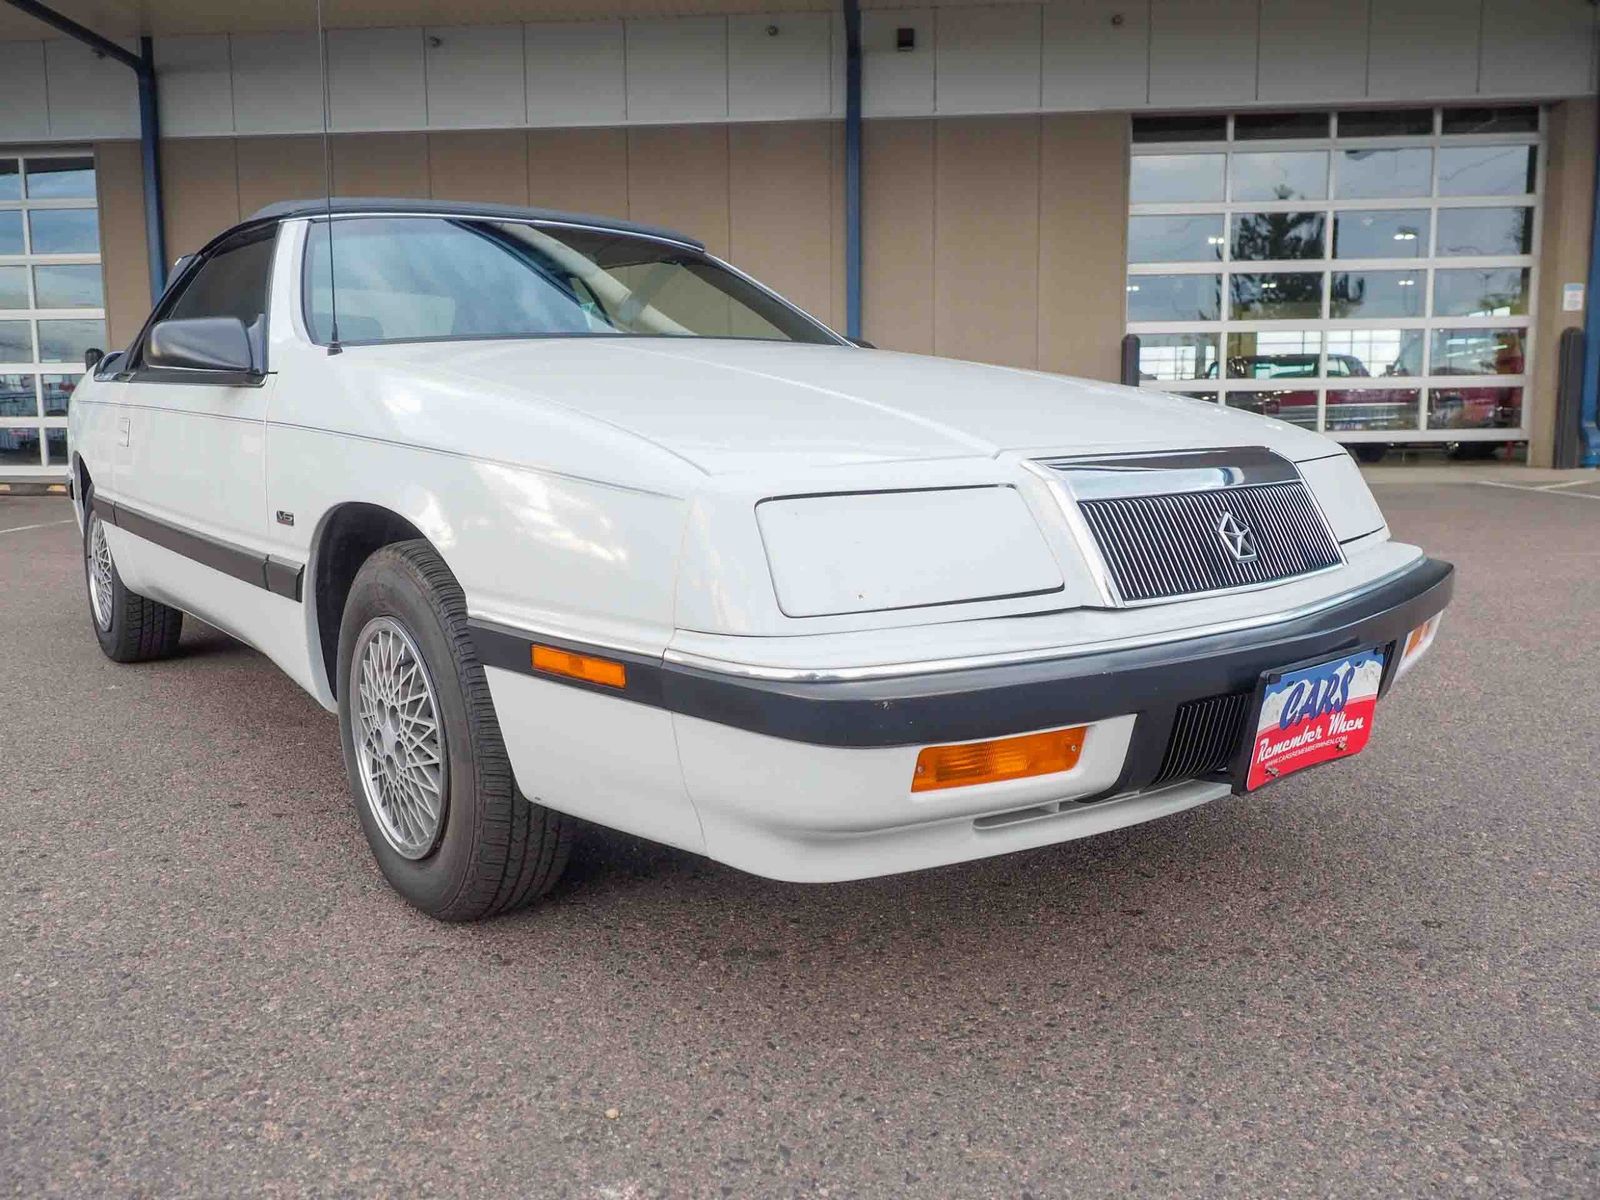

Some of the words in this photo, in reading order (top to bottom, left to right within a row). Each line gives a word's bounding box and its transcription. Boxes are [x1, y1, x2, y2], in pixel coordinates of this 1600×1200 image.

[277, 510, 294, 523] V6
[1279, 665, 1355, 730] CARS
[1257, 725, 1322, 764] Remember
[1327, 711, 1364, 736] When
